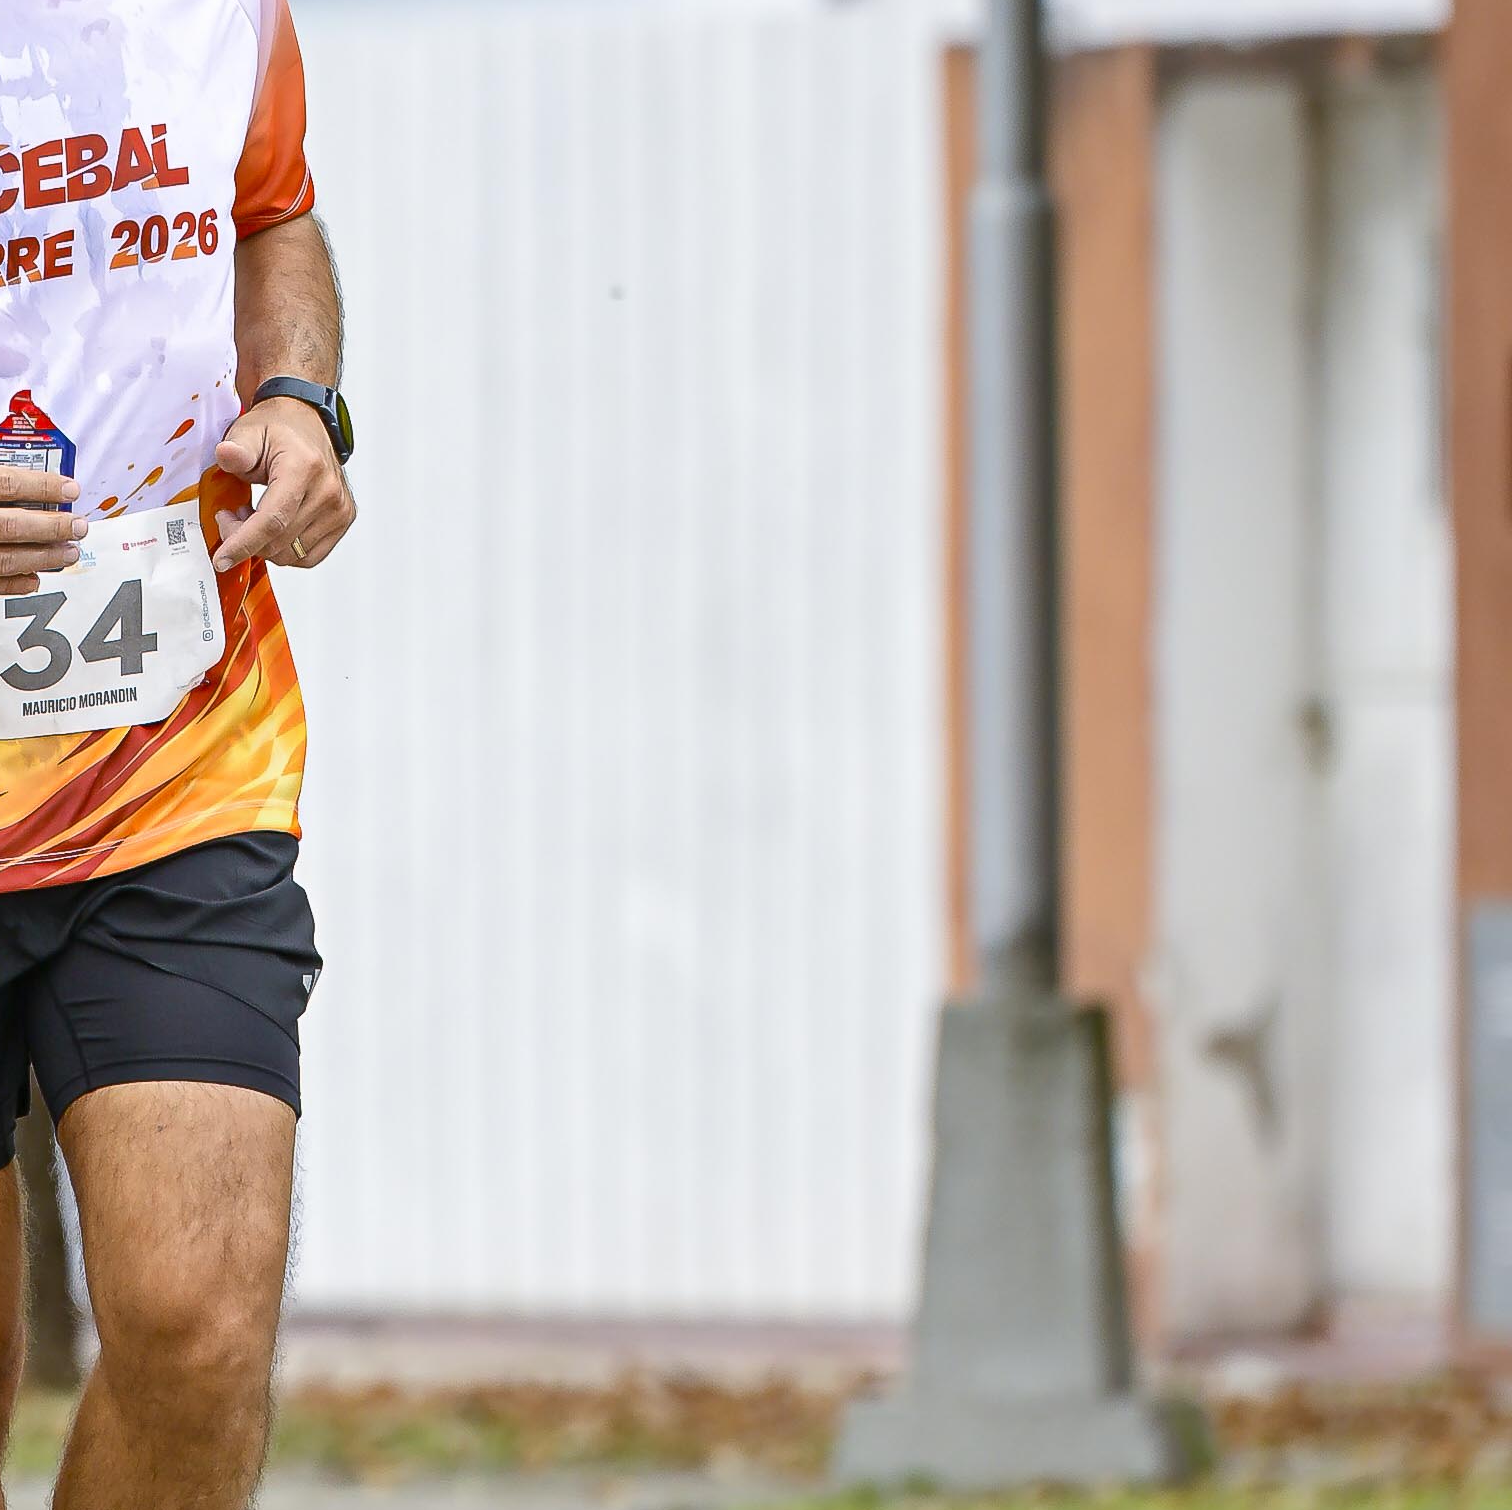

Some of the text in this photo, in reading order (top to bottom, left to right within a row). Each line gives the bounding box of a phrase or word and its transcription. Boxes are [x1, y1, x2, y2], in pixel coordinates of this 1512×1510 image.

[109, 208, 218, 271] 2026
[0, 579, 157, 691] 34
[22, 687, 137, 716] MAURICIO MORANDIN
